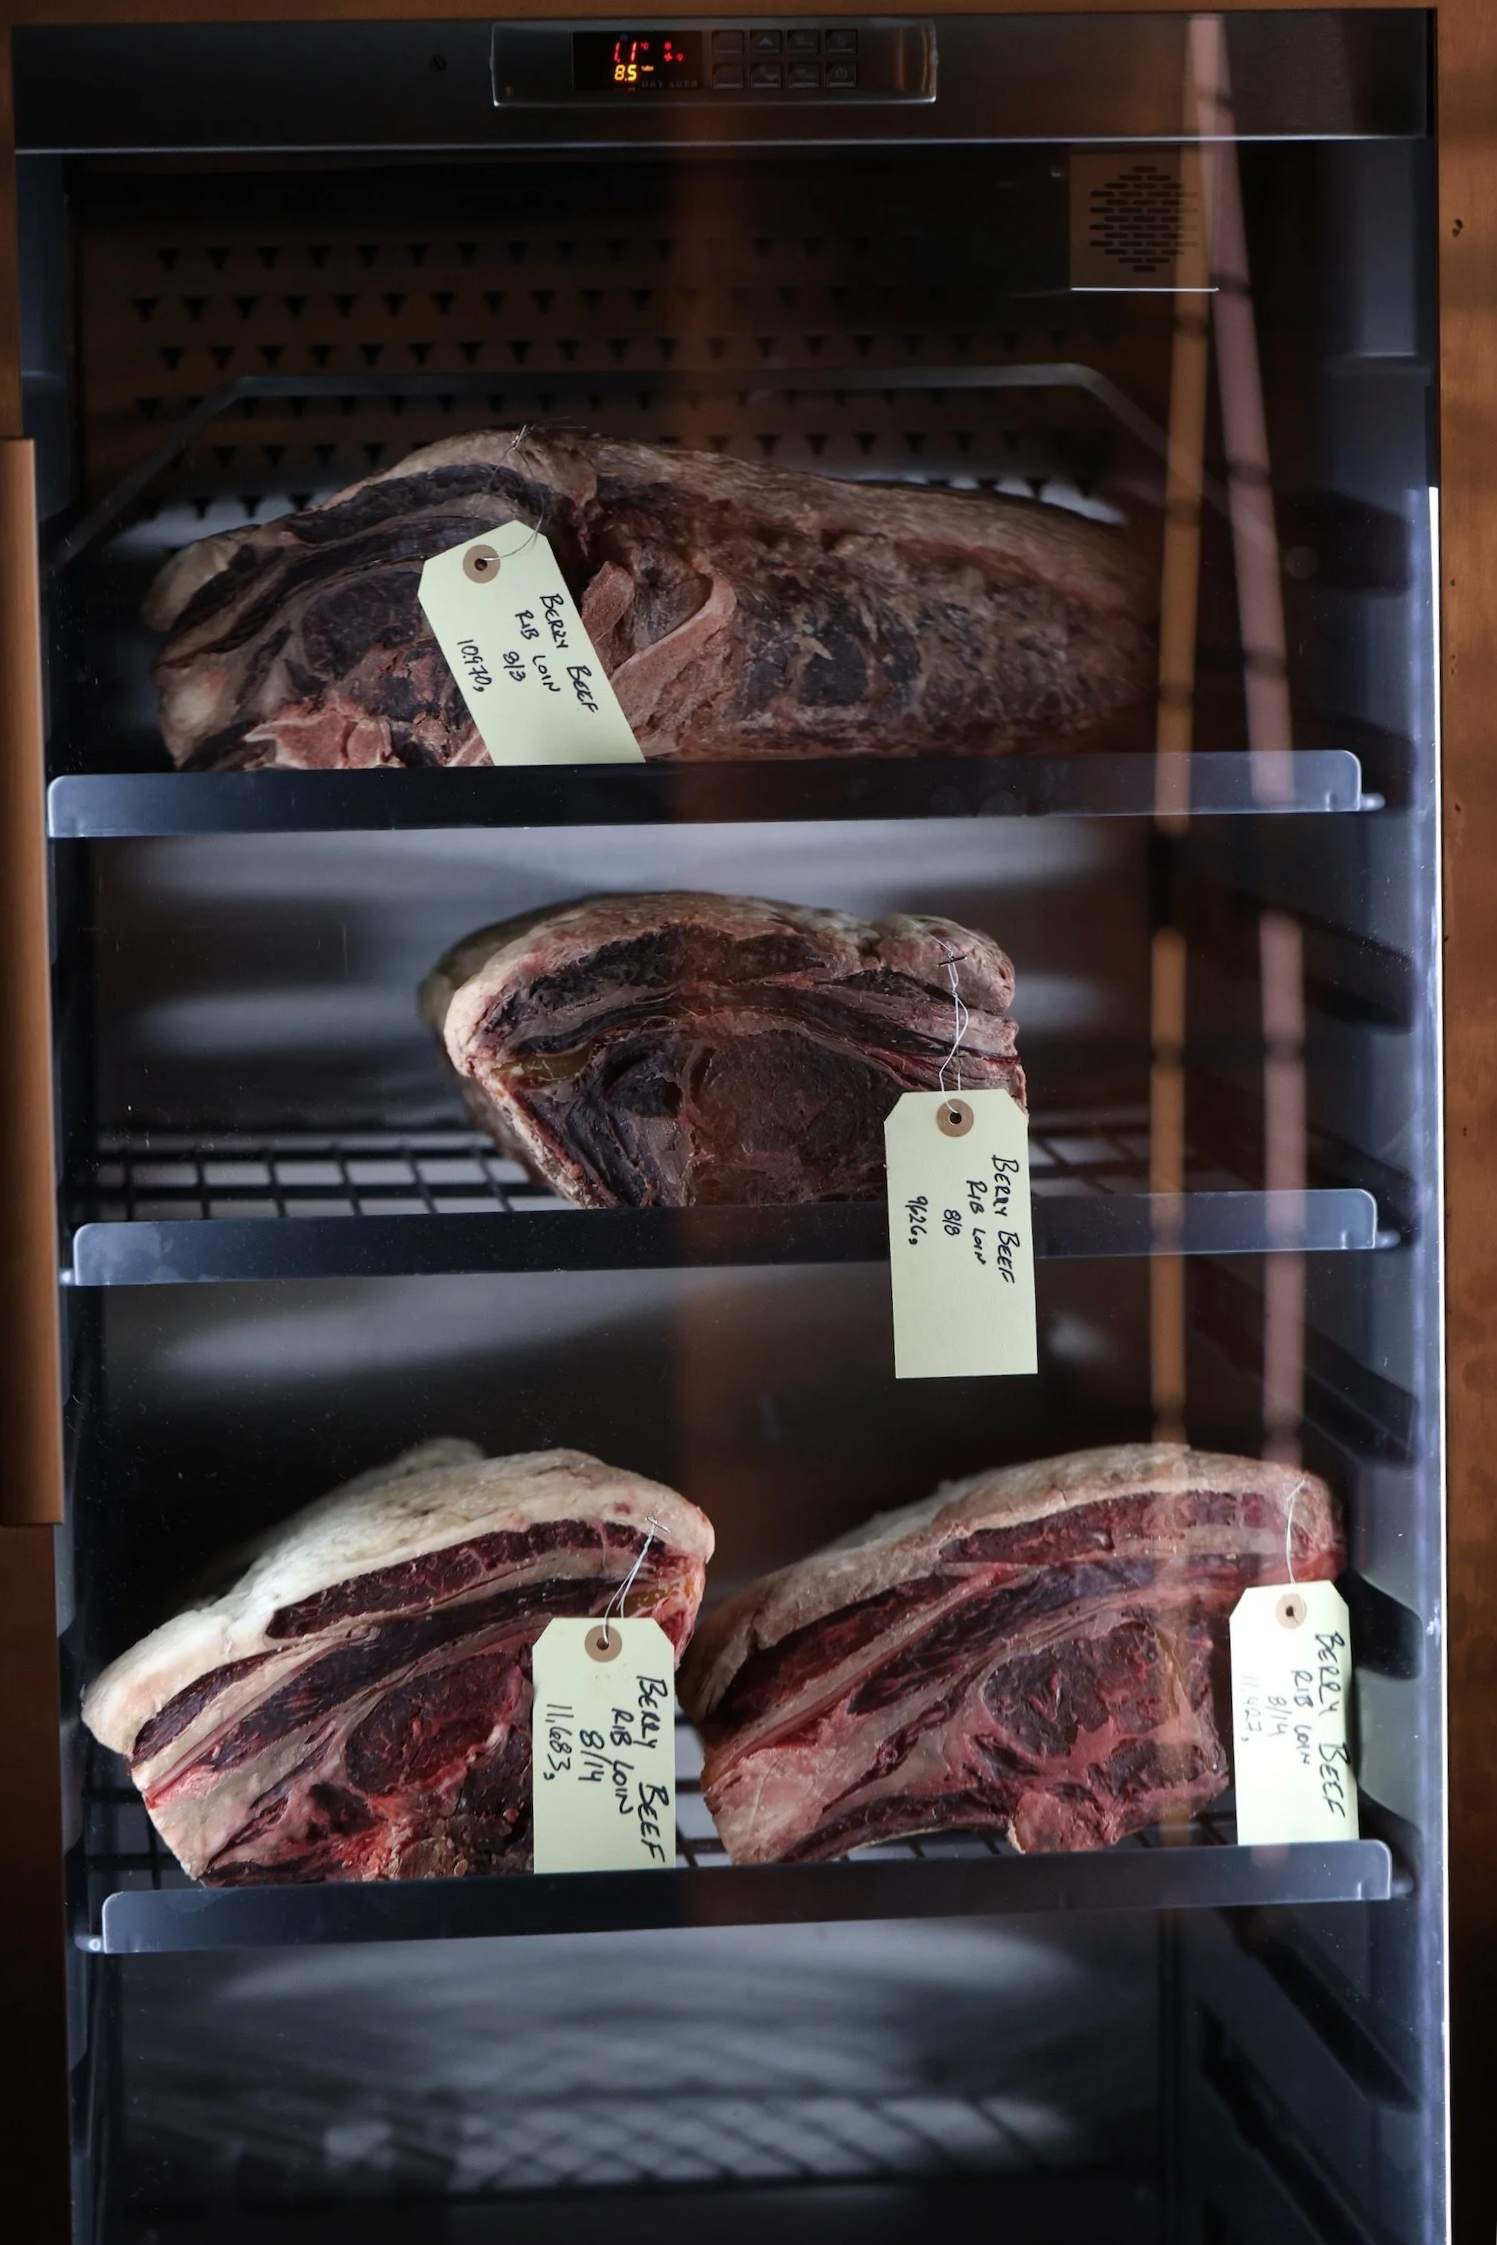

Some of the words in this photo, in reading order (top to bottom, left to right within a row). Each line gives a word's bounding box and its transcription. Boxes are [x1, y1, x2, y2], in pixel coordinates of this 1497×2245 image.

[515, 609, 540, 641] RIB
[531, 655, 561, 692] LOIN
[566, 665, 599, 714] BEEF
[942, 1209, 962, 1236] 8/8
[966, 1180, 988, 1215] RIB
[973, 1228, 987, 1266] LOIN
[997, 1230, 1021, 1284] BEEF
[1291, 1669, 1315, 1708] RIB
[1315, 1631, 1346, 1717] BERRY
[610, 1707, 634, 1747] RIB
[633, 1675, 669, 1749] BERRY
[1265, 1695, 1293, 1737] 8/14
[578, 1729, 613, 1782] 8/14
[1293, 1724, 1313, 1765] LOIN
[611, 1759, 635, 1815] LOIN
[1318, 1742, 1351, 1818] BEEF
[637, 1781, 670, 1863] BEEF
